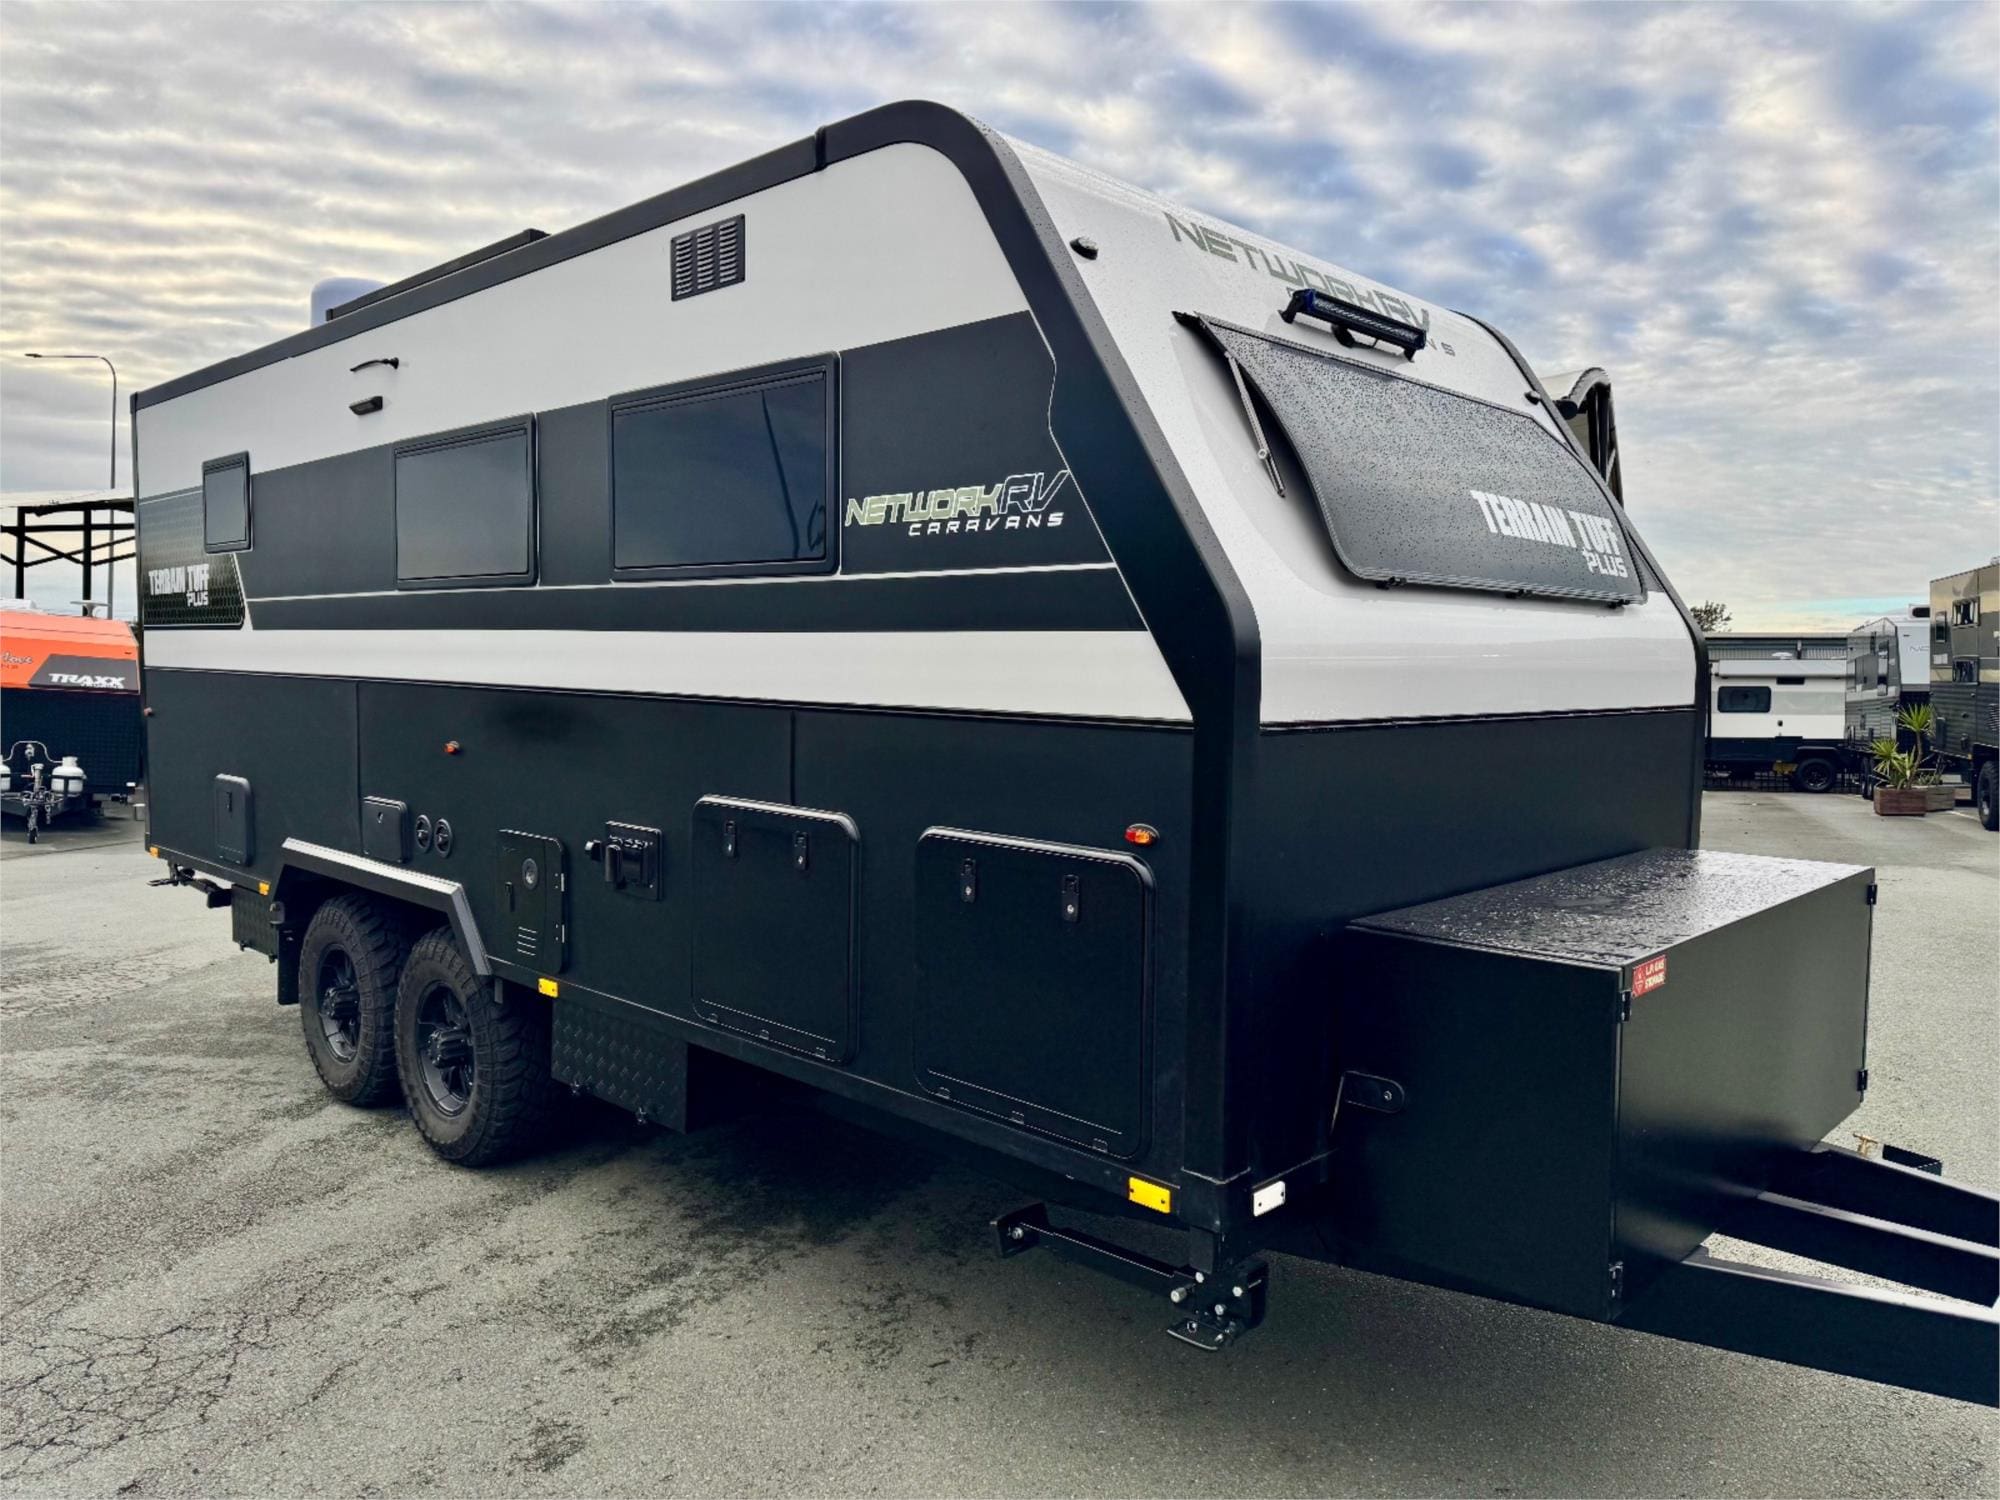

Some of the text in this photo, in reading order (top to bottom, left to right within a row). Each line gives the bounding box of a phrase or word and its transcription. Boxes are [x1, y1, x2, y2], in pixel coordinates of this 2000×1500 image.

[908, 512, 1064, 536] CARAVANS
[1470, 489, 1620, 555] TERRAIN TUFF
[1582, 547, 1628, 578] PLUS
[148, 563, 209, 595] TERRAIN TUFF
[186, 590, 209, 607] PLUS
[48, 673, 125, 687] TRAXX
